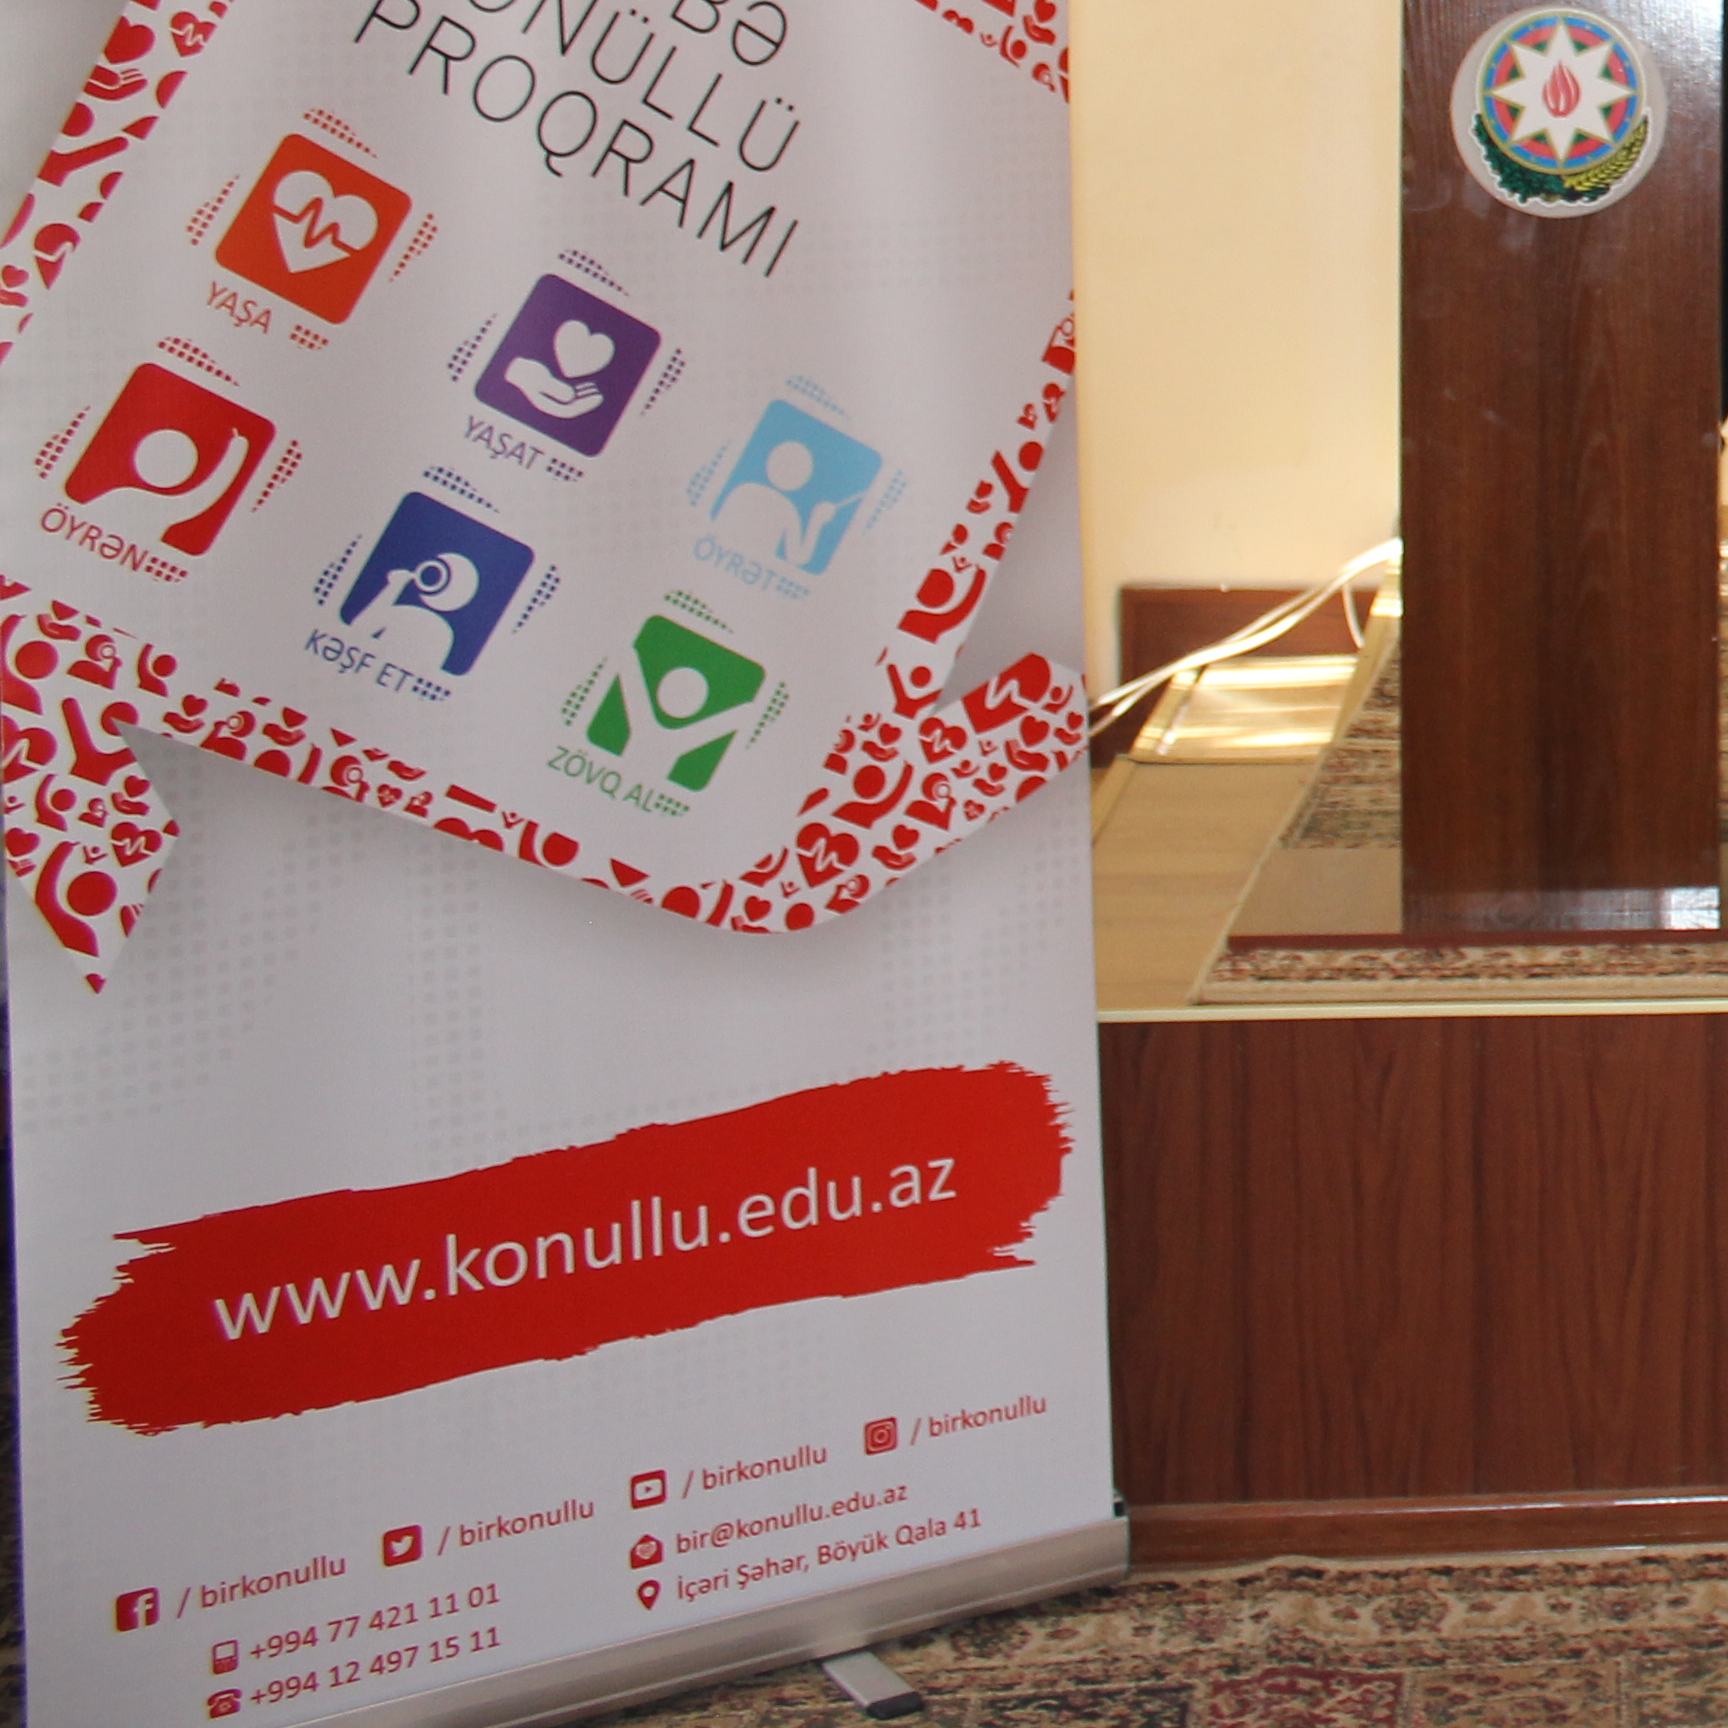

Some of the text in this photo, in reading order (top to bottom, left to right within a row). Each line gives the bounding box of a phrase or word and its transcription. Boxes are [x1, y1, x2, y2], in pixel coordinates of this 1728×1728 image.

[206, 281, 273, 335] YAŞA
[464, 415, 545, 470] YAŞAT
[40, 502, 149, 572] ÖYRƏN
[693, 533, 778, 591] ÖYRƏT
[304, 628, 415, 692] KƏŞF ET
[546, 744, 655, 814] ZÖVQ AL
[212, 1154, 958, 1341] www.konullu.edu.az
[928, 1393, 1048, 1438] birkonullu
[701, 1444, 829, 1491] birkonullu
[458, 1498, 595, 1547] birkonullu
[675, 1484, 909, 1555] bir@konullu.edu.az
[200, 1555, 347, 1608] birkonullu
[677, 1507, 982, 1601] İçəri Şəhər, Böyük Qala 41
[250, 1583, 501, 1660] +994 77 421 11 01
[250, 1627, 501, 1705] +994 12 497 15 11
